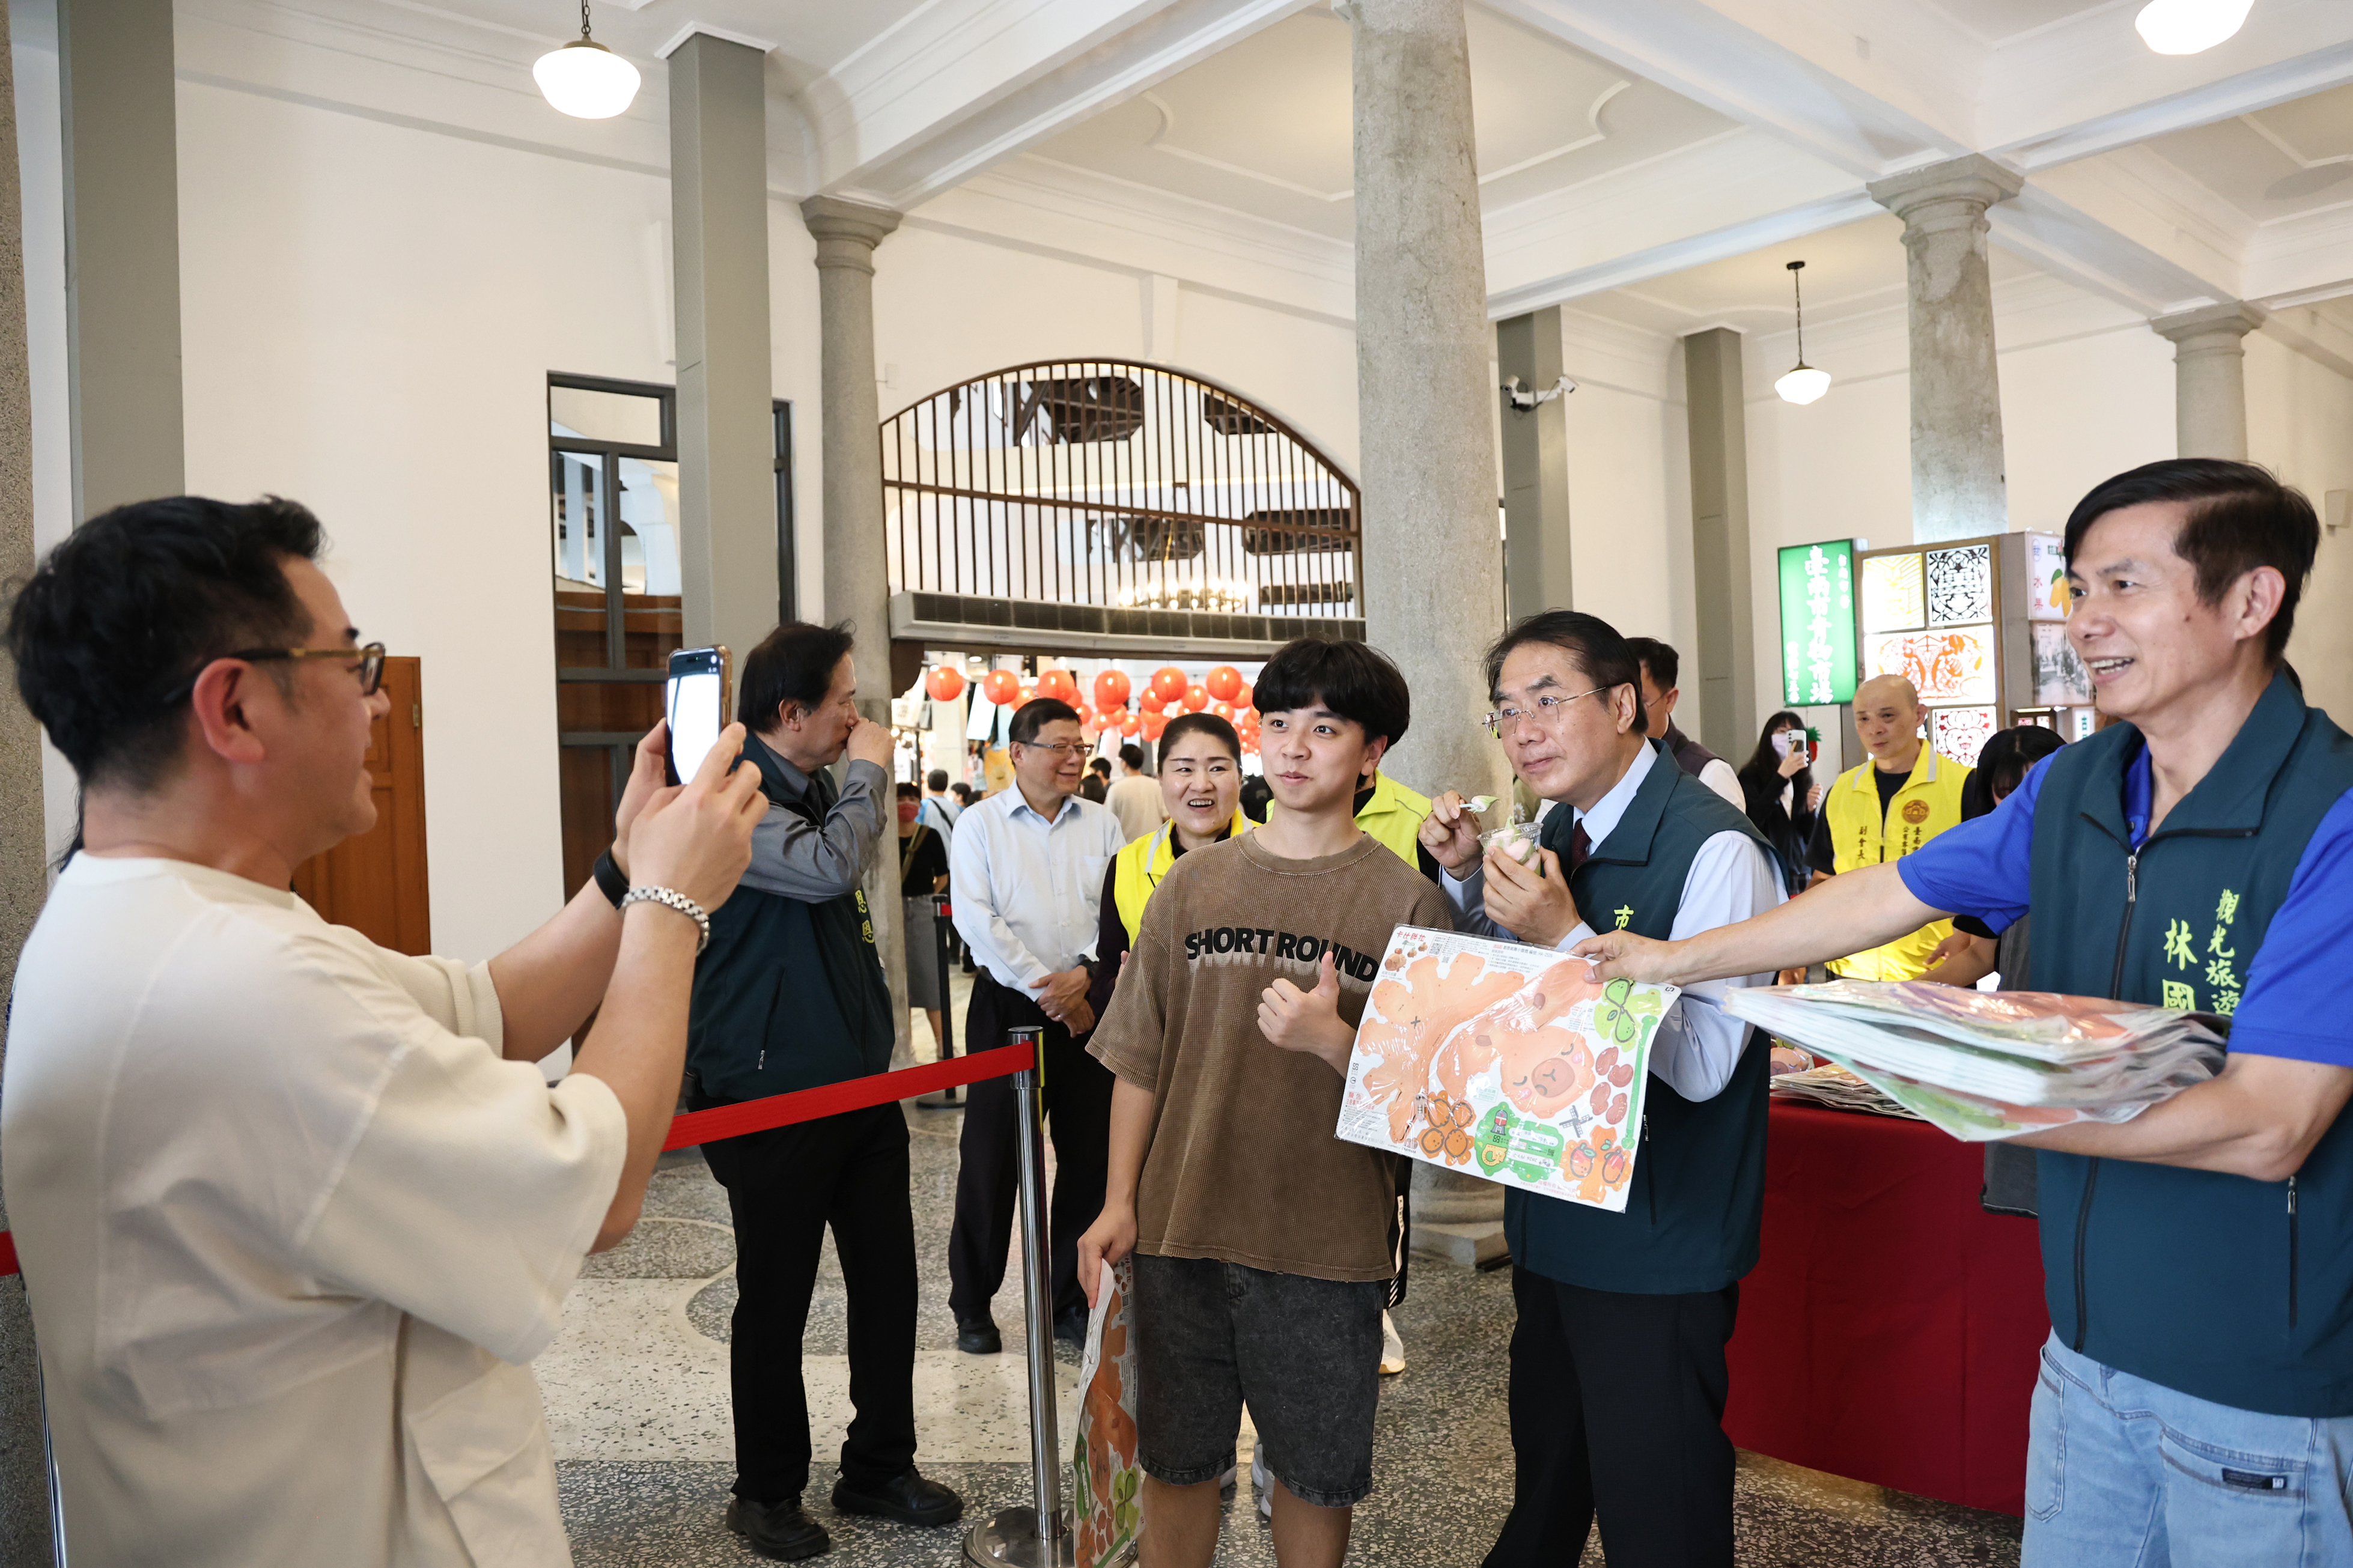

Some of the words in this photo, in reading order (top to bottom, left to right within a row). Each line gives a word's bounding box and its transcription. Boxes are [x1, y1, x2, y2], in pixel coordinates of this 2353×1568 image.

[1184, 926, 1274, 960] SHORT
[1275, 931, 1379, 982] ROUND
[2205, 888, 2242, 1017] 觀光旅遊
